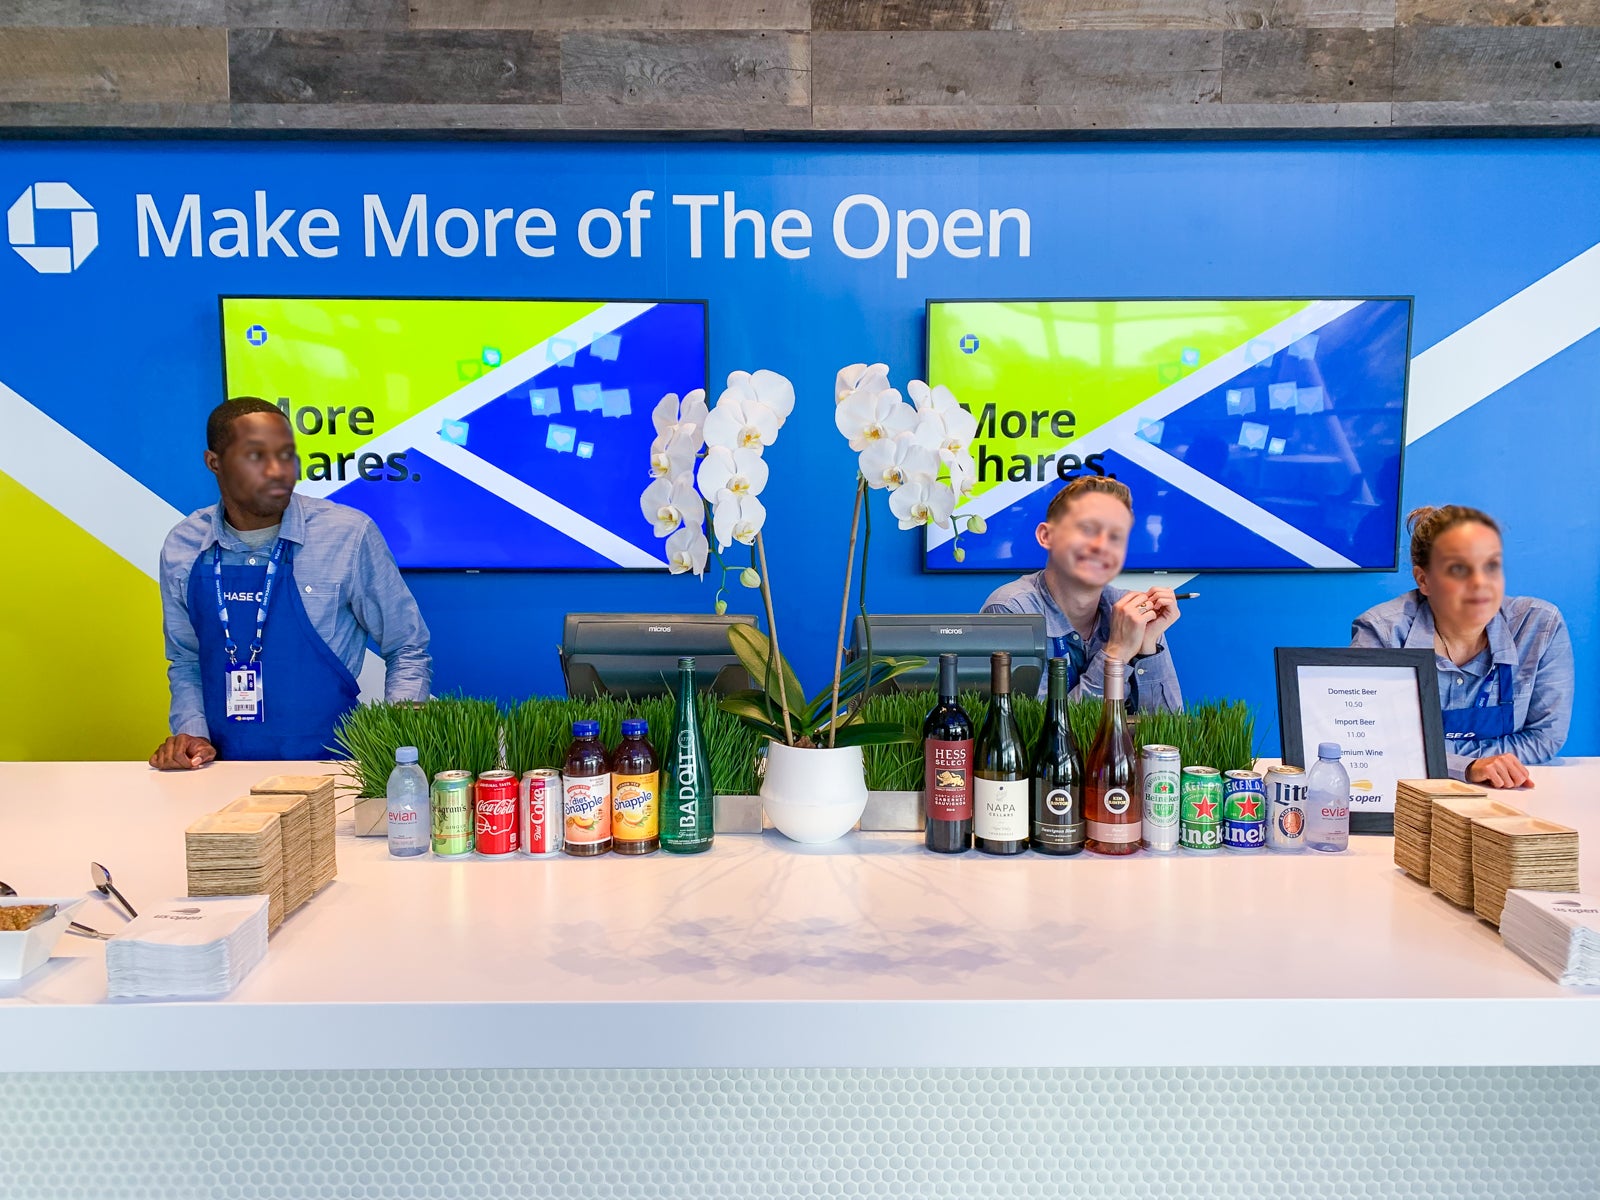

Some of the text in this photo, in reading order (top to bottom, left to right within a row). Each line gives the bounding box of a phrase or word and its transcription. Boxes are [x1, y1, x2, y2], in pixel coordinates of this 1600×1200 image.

[137, 190, 1031, 279] Make More of The Open
[296, 452, 421, 482] ares.
[973, 445, 1117, 482] hares.
[223, 591, 255, 602] HASE
[648, 625, 672, 633] micros
[940, 627, 963, 635] micros
[1334, 718, 1359, 726] Import
[935, 748, 966, 760] HESS
[572, 796, 588, 804] diet
[1274, 782, 1309, 806] Lite
[1355, 794, 1382, 804] open
[477, 797, 517, 816] Coca-Cola
[531, 788, 544, 825] Coke
[565, 795, 603, 815] Snapple
[614, 791, 652, 811] Snapple
[986, 803, 1016, 812] NAPA
[388, 811, 417, 822] evian
